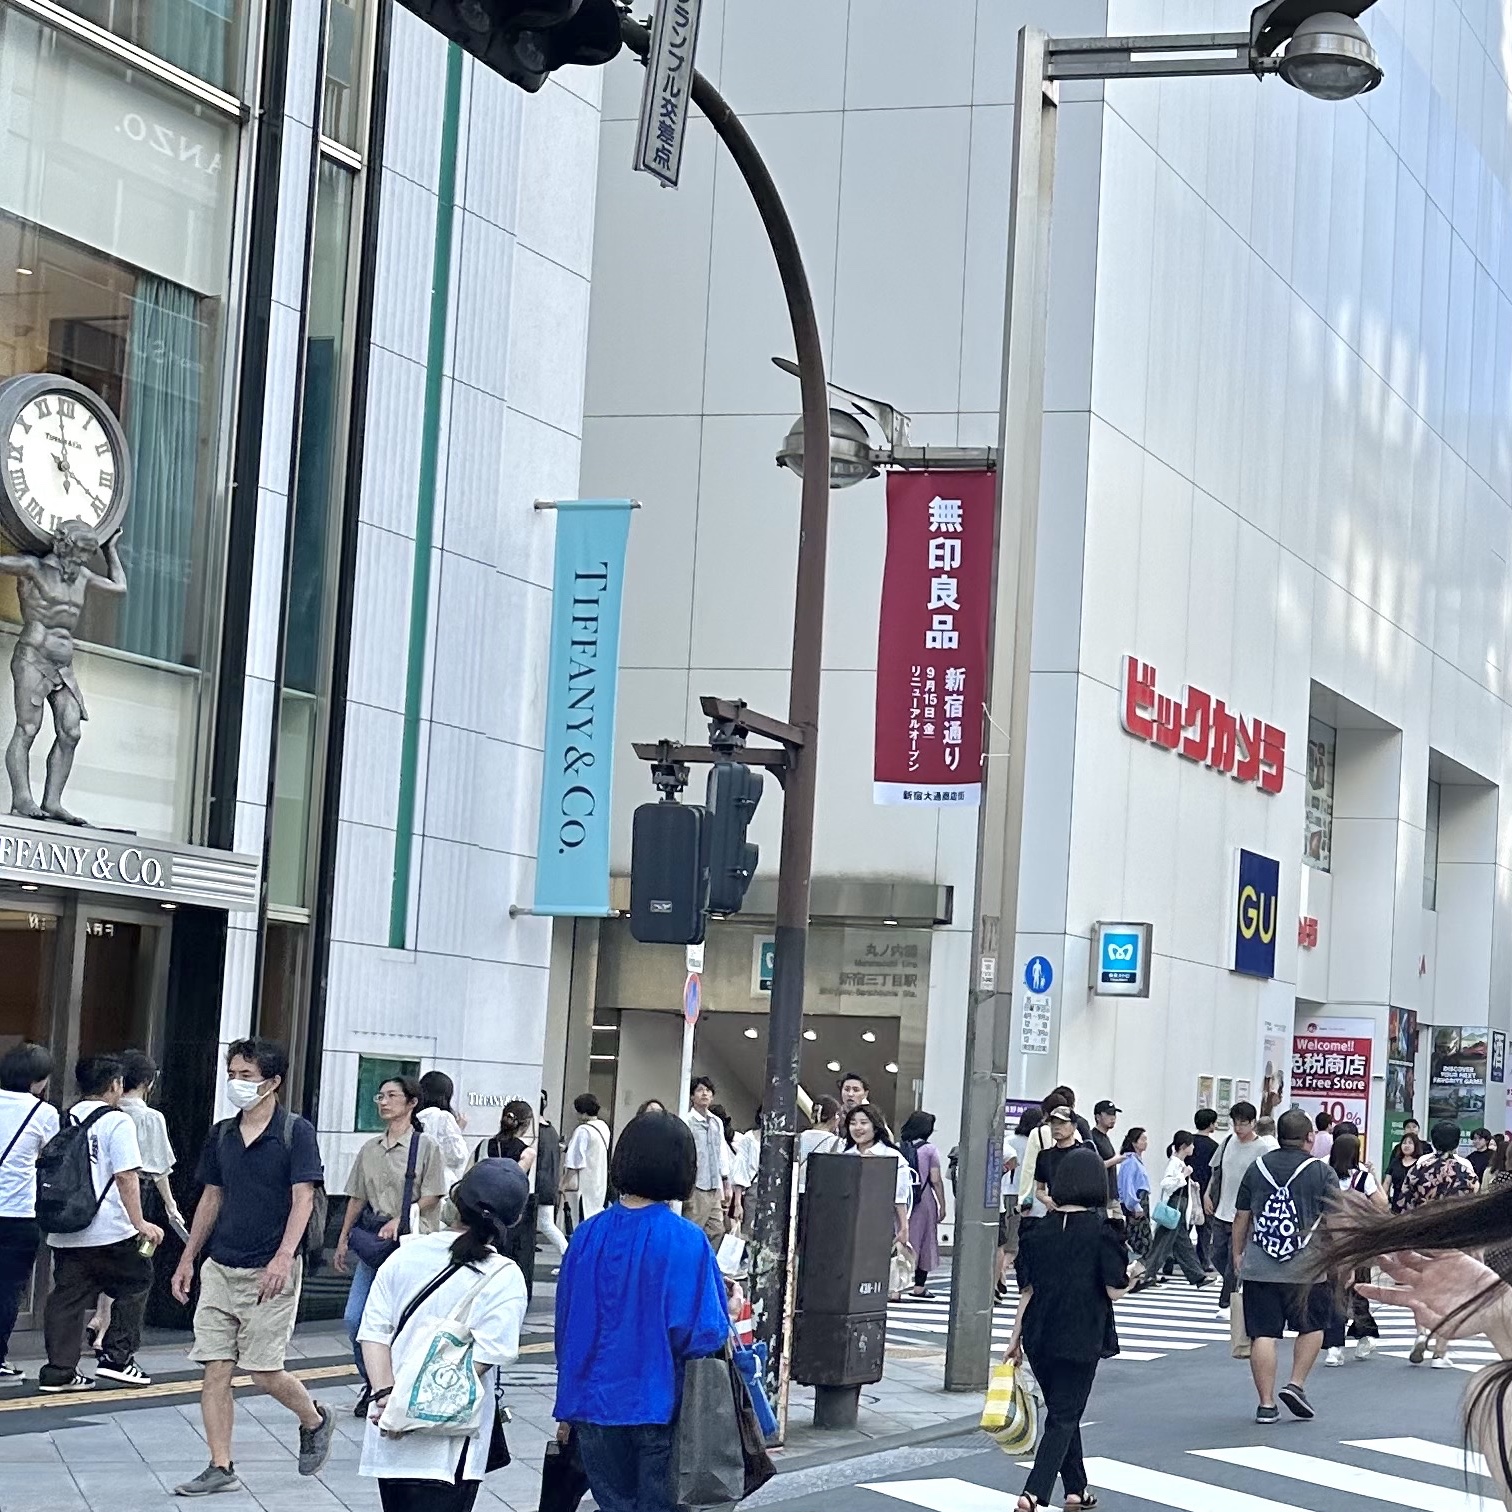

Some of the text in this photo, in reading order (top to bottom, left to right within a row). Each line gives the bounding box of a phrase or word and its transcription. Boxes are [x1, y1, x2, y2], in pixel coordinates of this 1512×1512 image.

[653, 0, 689, 171] ランブル交差点
[925, 496, 963, 650] 無印良品
[565, 562, 608, 739] TIFFANY
[563, 746, 595, 776] &
[908, 665, 921, 772] リニューアルオープン
[943, 667, 966, 771] 新宿通り
[1121, 654, 1286, 794] ビックカメラ
[92, 847, 115, 880] &
[1240, 885, 1276, 945] GU
[1296, 1038, 1355, 1052] Welcome!!
[1305, 1077, 1332, 1089] Free
[1333, 1077, 1365, 1091] Store
